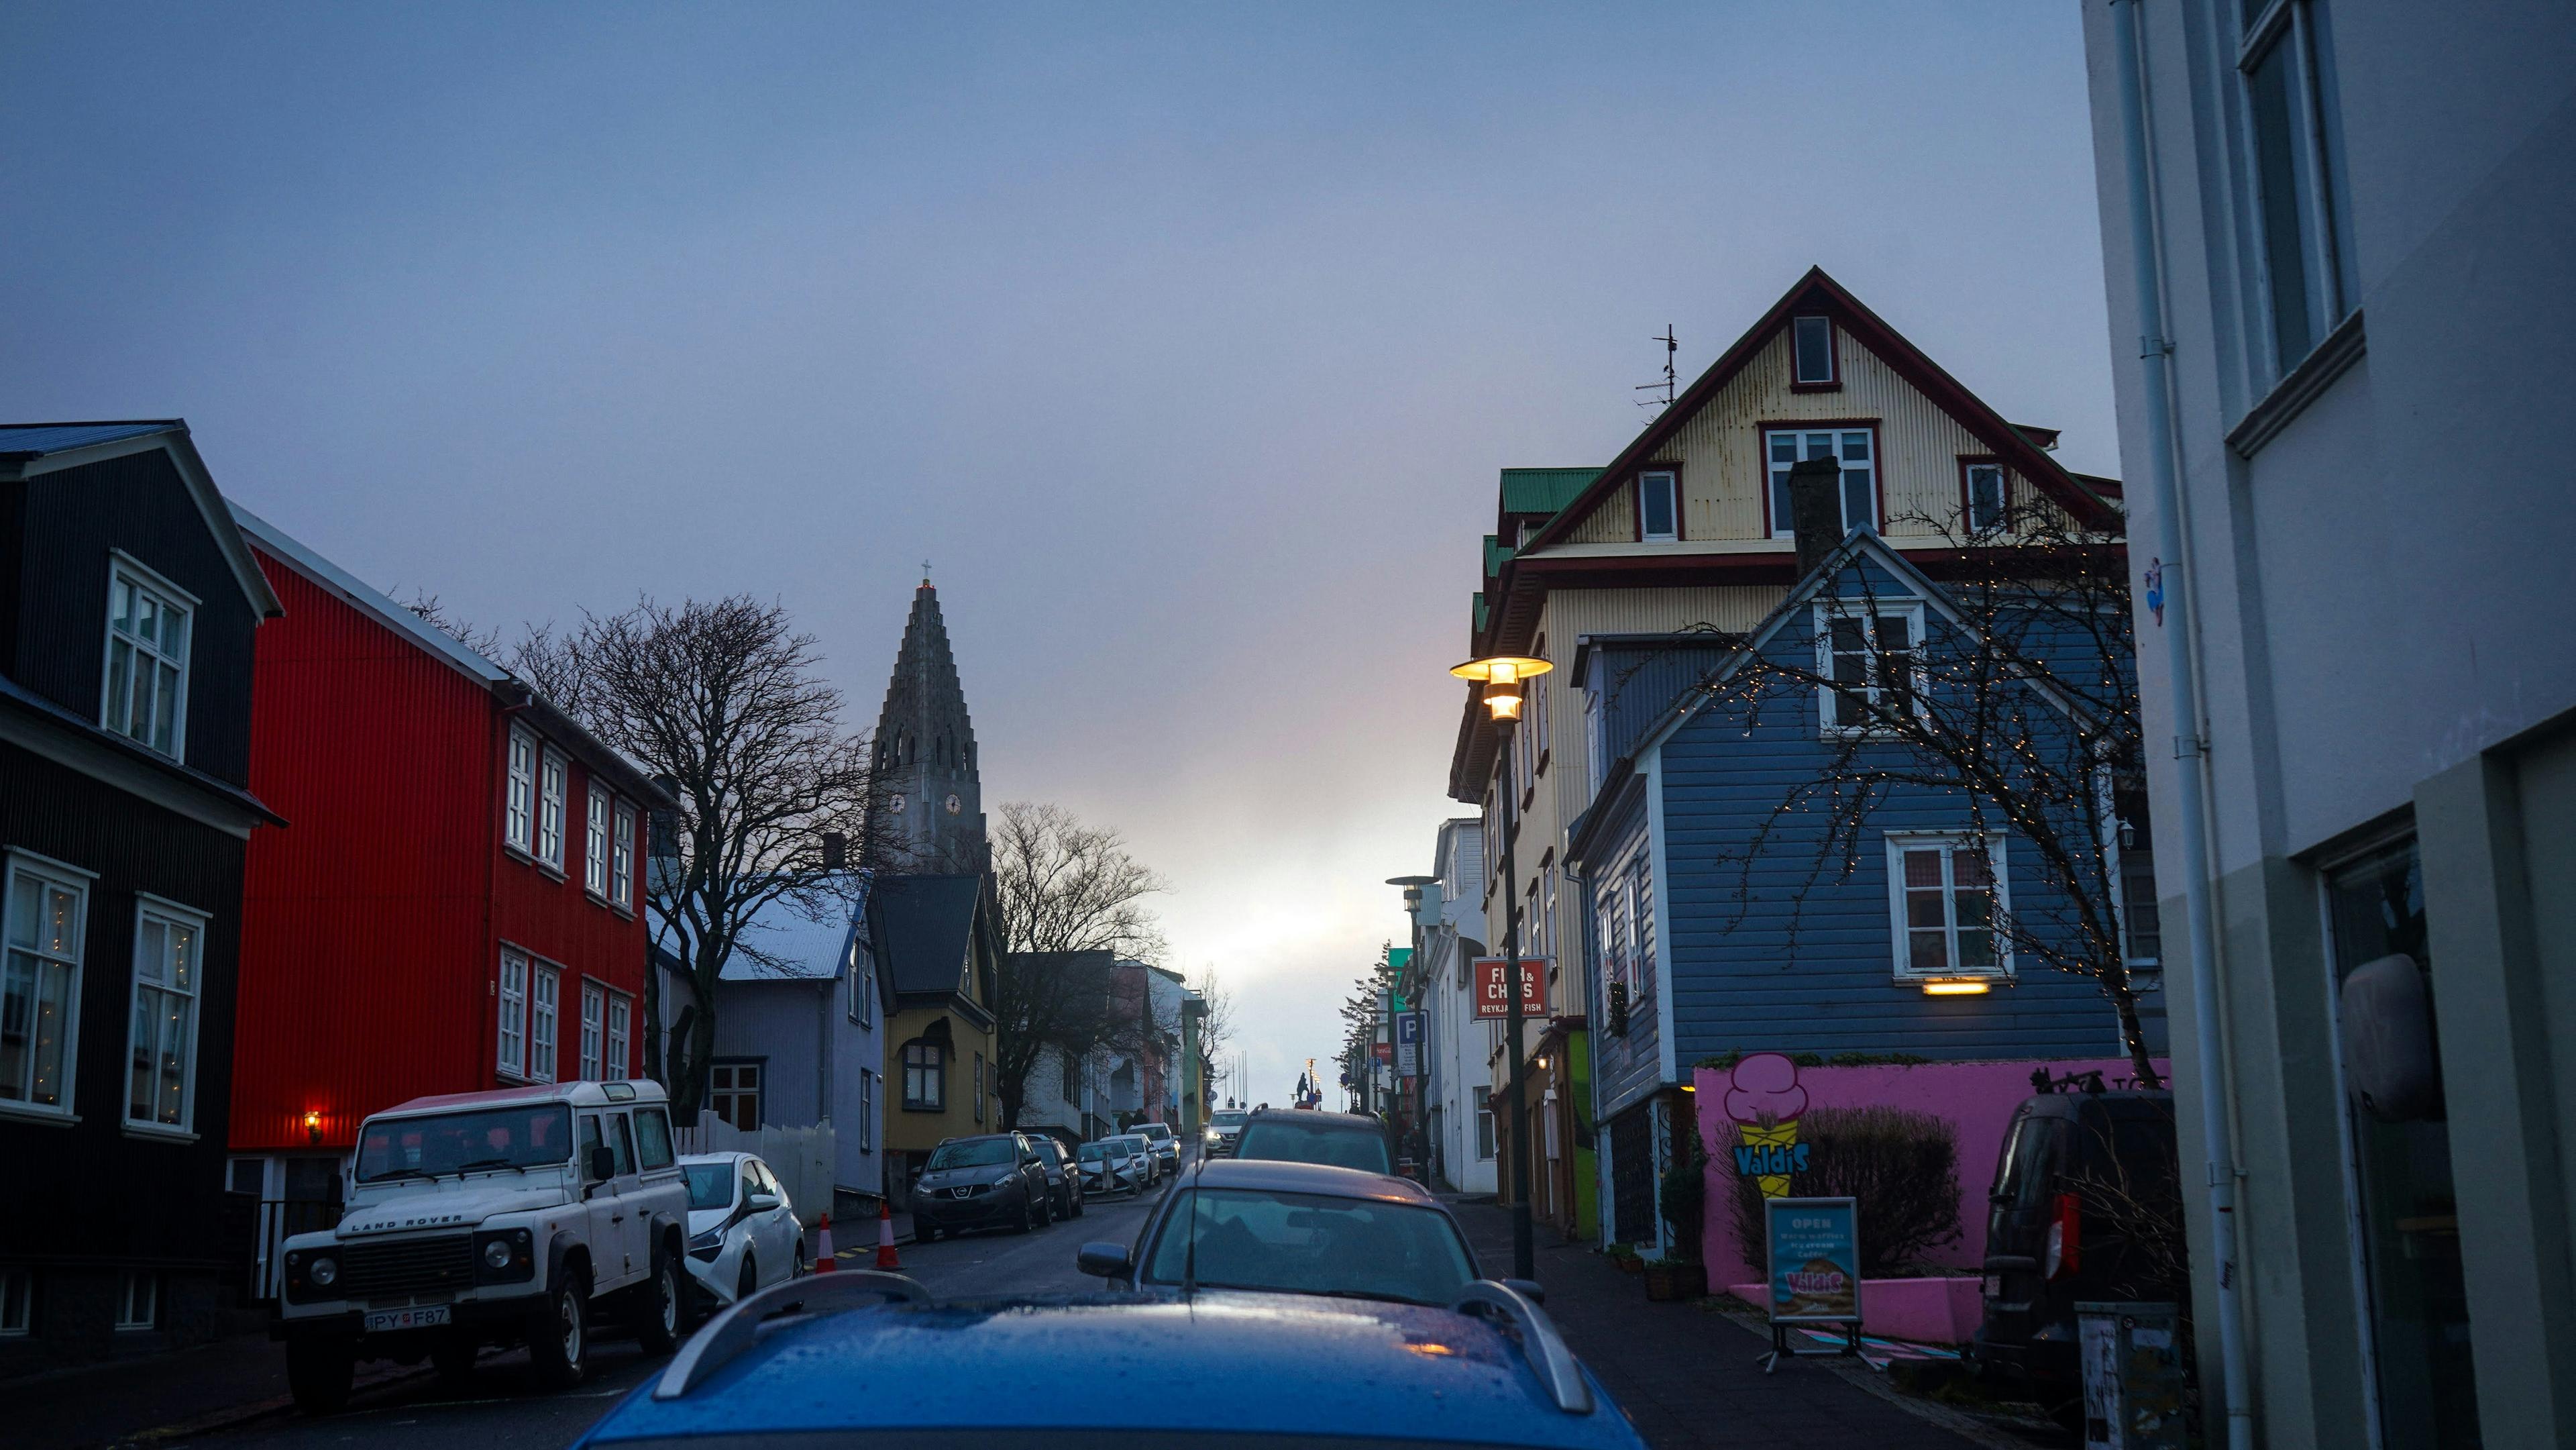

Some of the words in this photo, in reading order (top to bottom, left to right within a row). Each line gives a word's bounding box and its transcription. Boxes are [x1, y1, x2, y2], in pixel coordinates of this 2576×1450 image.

[1487, 983, 1533, 999] CHS
[1524, 1003, 1542, 1013] FISH
[1405, 1019, 1417, 1039] P
[352, 1222, 396, 1231] LAND
[406, 1215, 462, 1226] ROVER
[1792, 1218, 1832, 1229] OPEN
[374, 1314, 398, 1330] PY
[413, 1308, 445, 1325] F87
